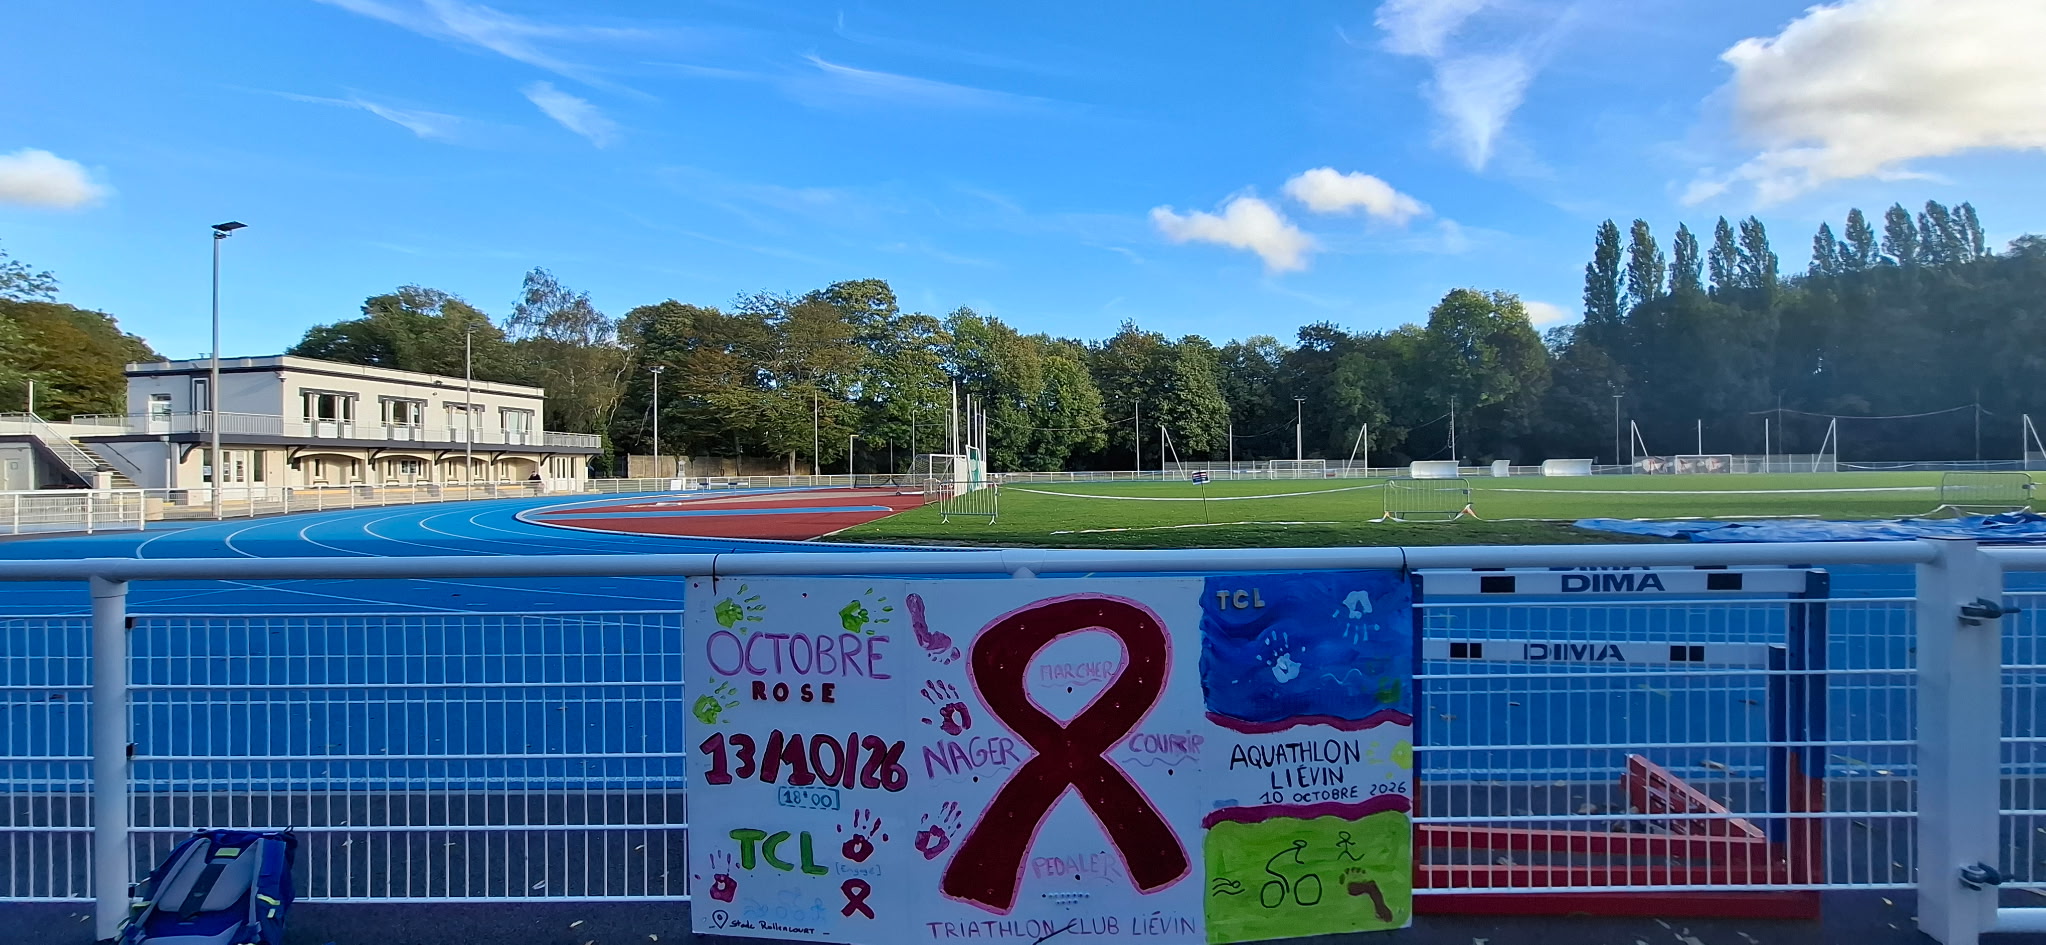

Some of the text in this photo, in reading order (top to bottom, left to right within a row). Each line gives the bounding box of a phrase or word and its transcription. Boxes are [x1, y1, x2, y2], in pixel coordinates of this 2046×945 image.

[1561, 573, 1666, 593] DIMA
[1216, 588, 1266, 610] TCL
[706, 629, 892, 680] OCTOBRE
[1523, 643, 1626, 662] DIMA
[1039, 660, 1113, 681] MARCHER
[751, 680, 836, 704] ROSE
[698, 728, 909, 792] 13/10/26
[922, 735, 1021, 780] NAGER
[1229, 738, 1361, 770] AQUATHLON
[1270, 764, 1344, 790] LIÉVIN
[1259, 781, 1407, 804] 10 OCTOBRE 2026
[729, 827, 829, 876] TCL
[1031, 852, 1123, 879] PEDALER
[729, 919, 756, 930] Stade
[926, 917, 1056, 939] TRIATHLON
[1066, 917, 1121, 935] CLUB
